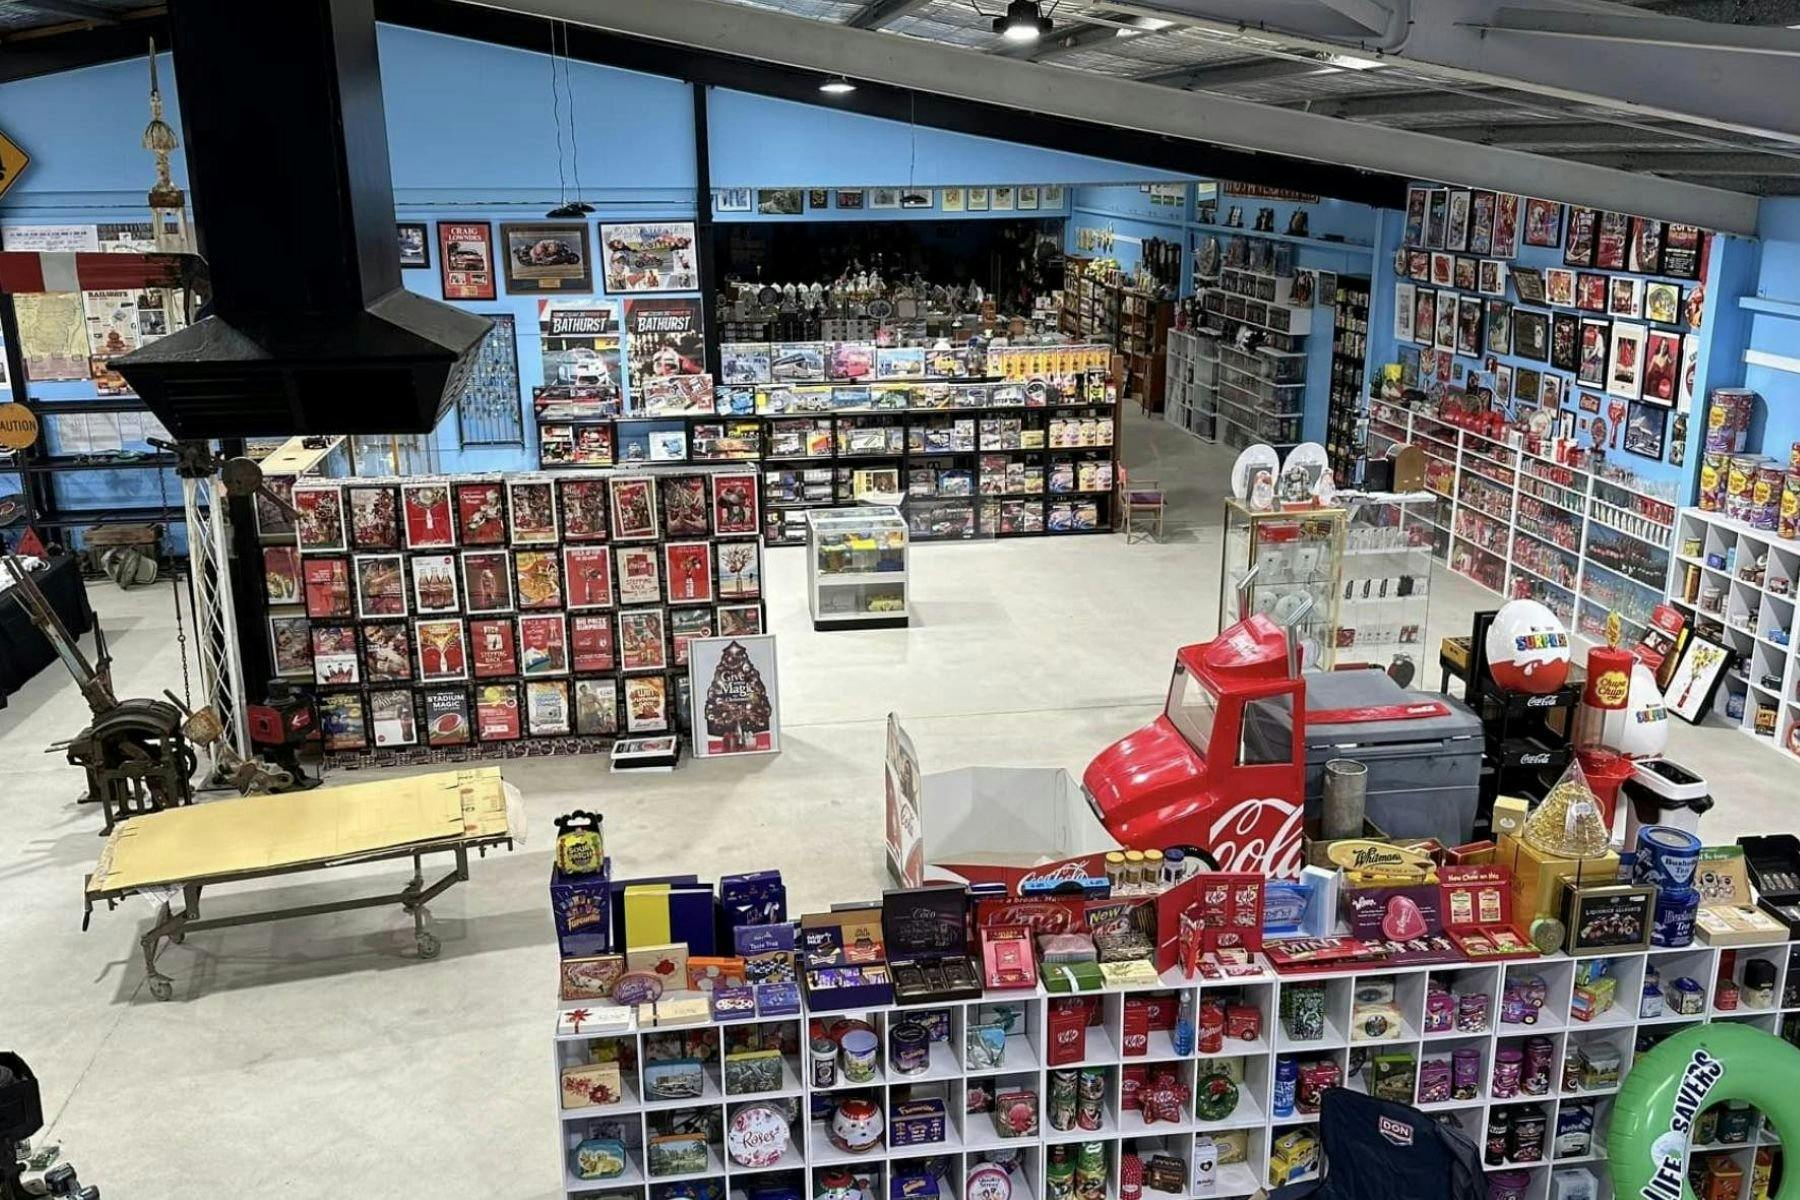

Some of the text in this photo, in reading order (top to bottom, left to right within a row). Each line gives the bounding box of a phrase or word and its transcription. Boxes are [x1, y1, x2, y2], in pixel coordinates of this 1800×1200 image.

[451, 227, 478, 235] CRAIG
[553, 317, 607, 333] BATHURST
[637, 316, 691, 332] BATHURST
[0, 421, 36, 432] AUTION
[721, 671, 746, 681] Give
[1599, 678, 1627, 688] Chupa
[720, 682, 755, 697] Magic
[1598, 686, 1626, 697] Chups
[427, 694, 465, 703] STADIUM
[1527, 695, 1558, 707] Coca-Cola
[1520, 753, 1551, 765] Coca-Cola
[1671, 1050, 1722, 1134] SAVERS
[1382, 1120, 1409, 1136] DON
[742, 1130, 775, 1150] Roses
